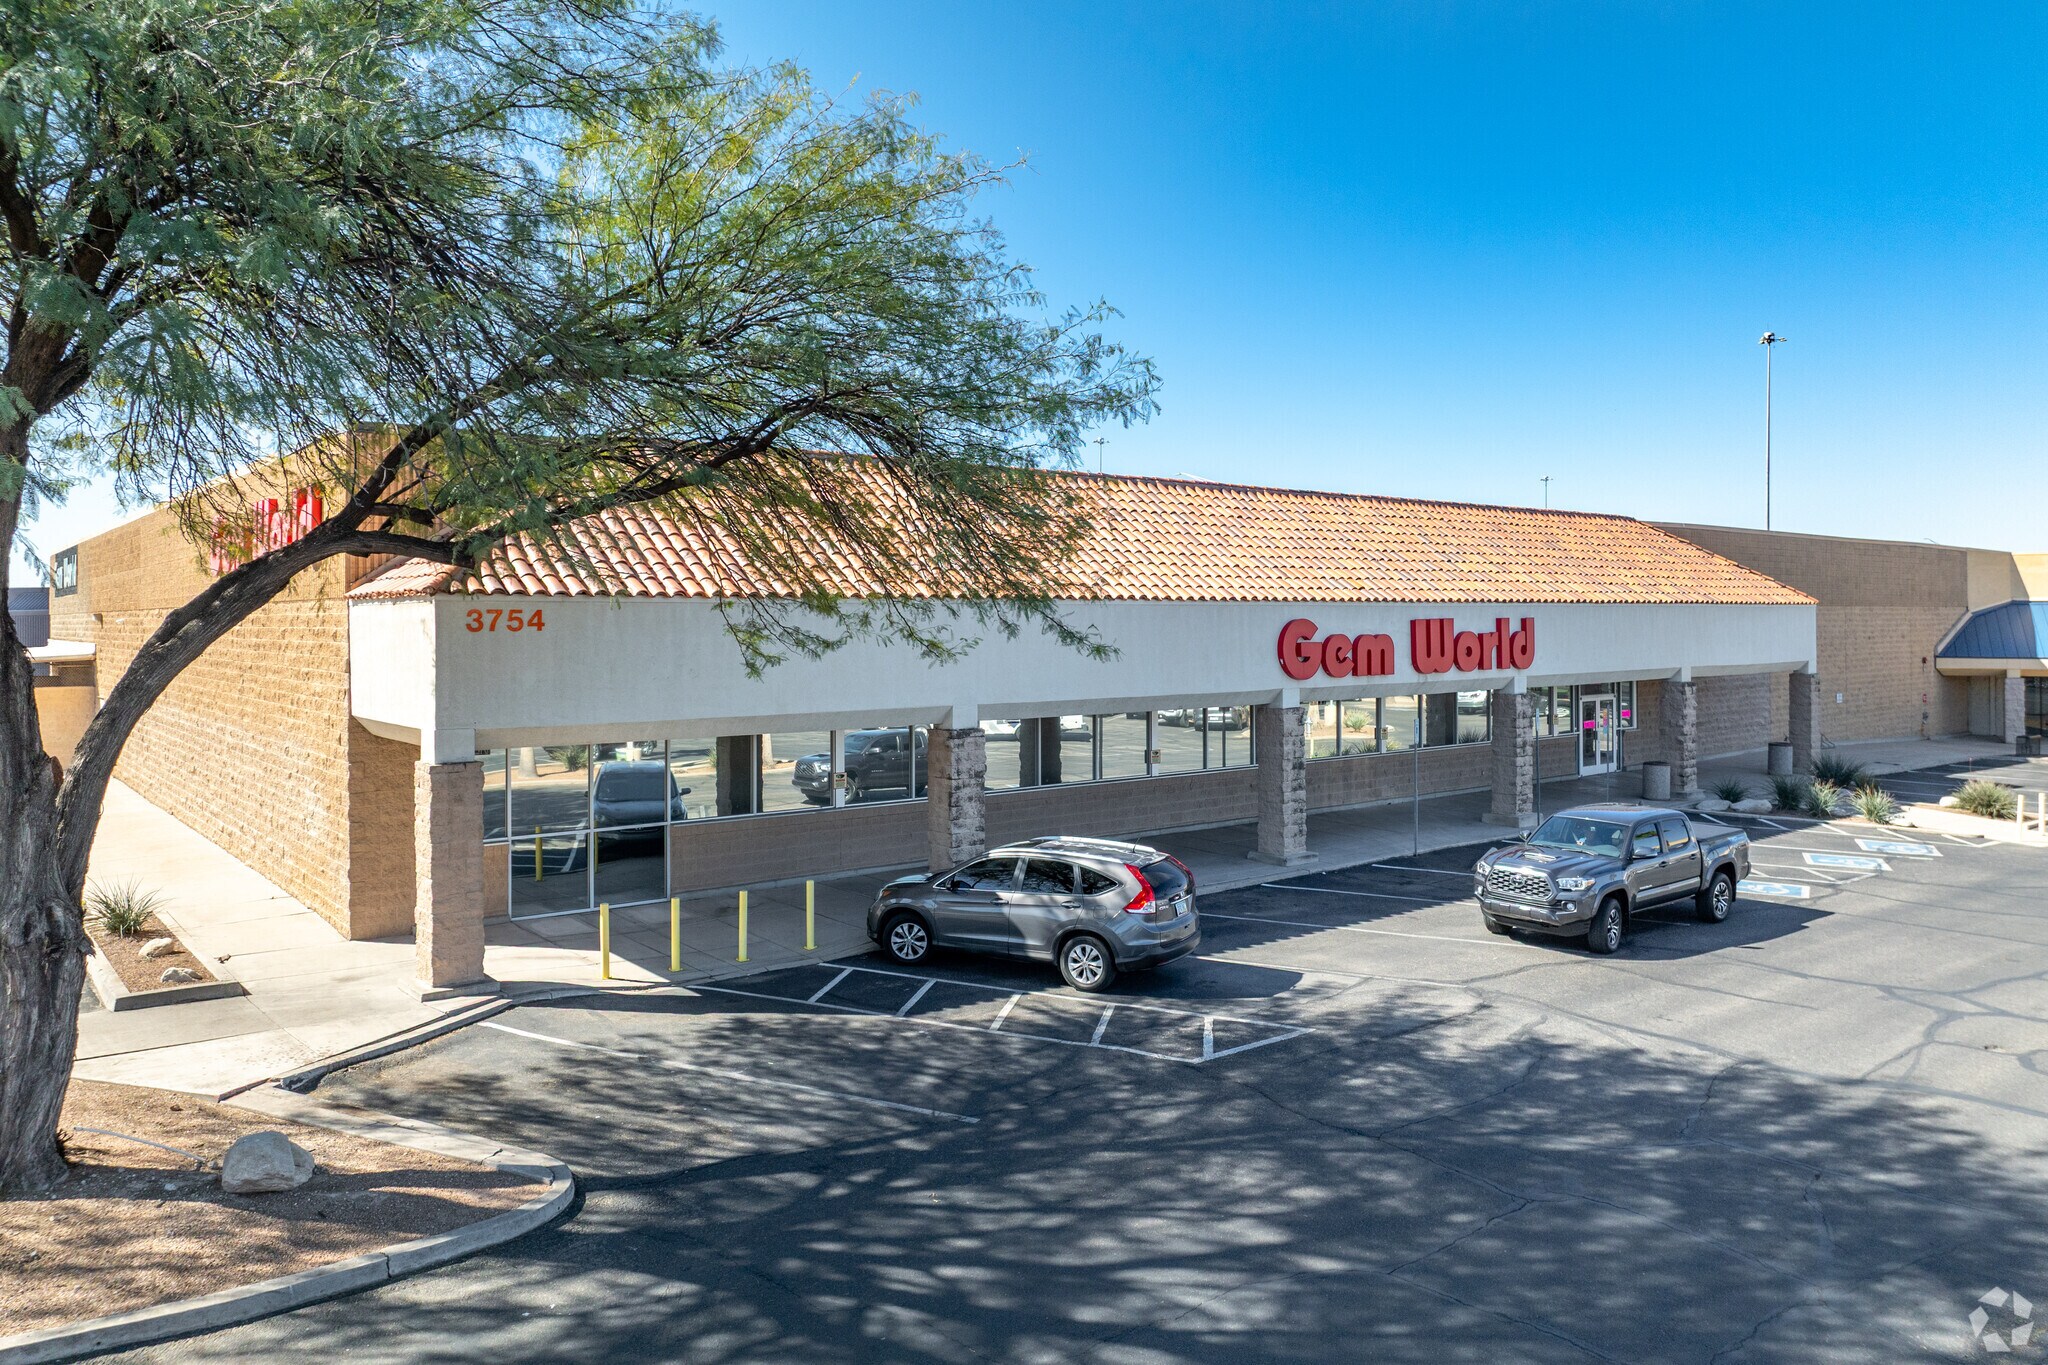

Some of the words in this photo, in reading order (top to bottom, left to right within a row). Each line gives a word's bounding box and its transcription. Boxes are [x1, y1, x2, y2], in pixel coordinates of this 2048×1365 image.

[465, 608, 545, 633] 3754
[1277, 618, 1395, 680] Gem
[1410, 617, 1535, 674] World
